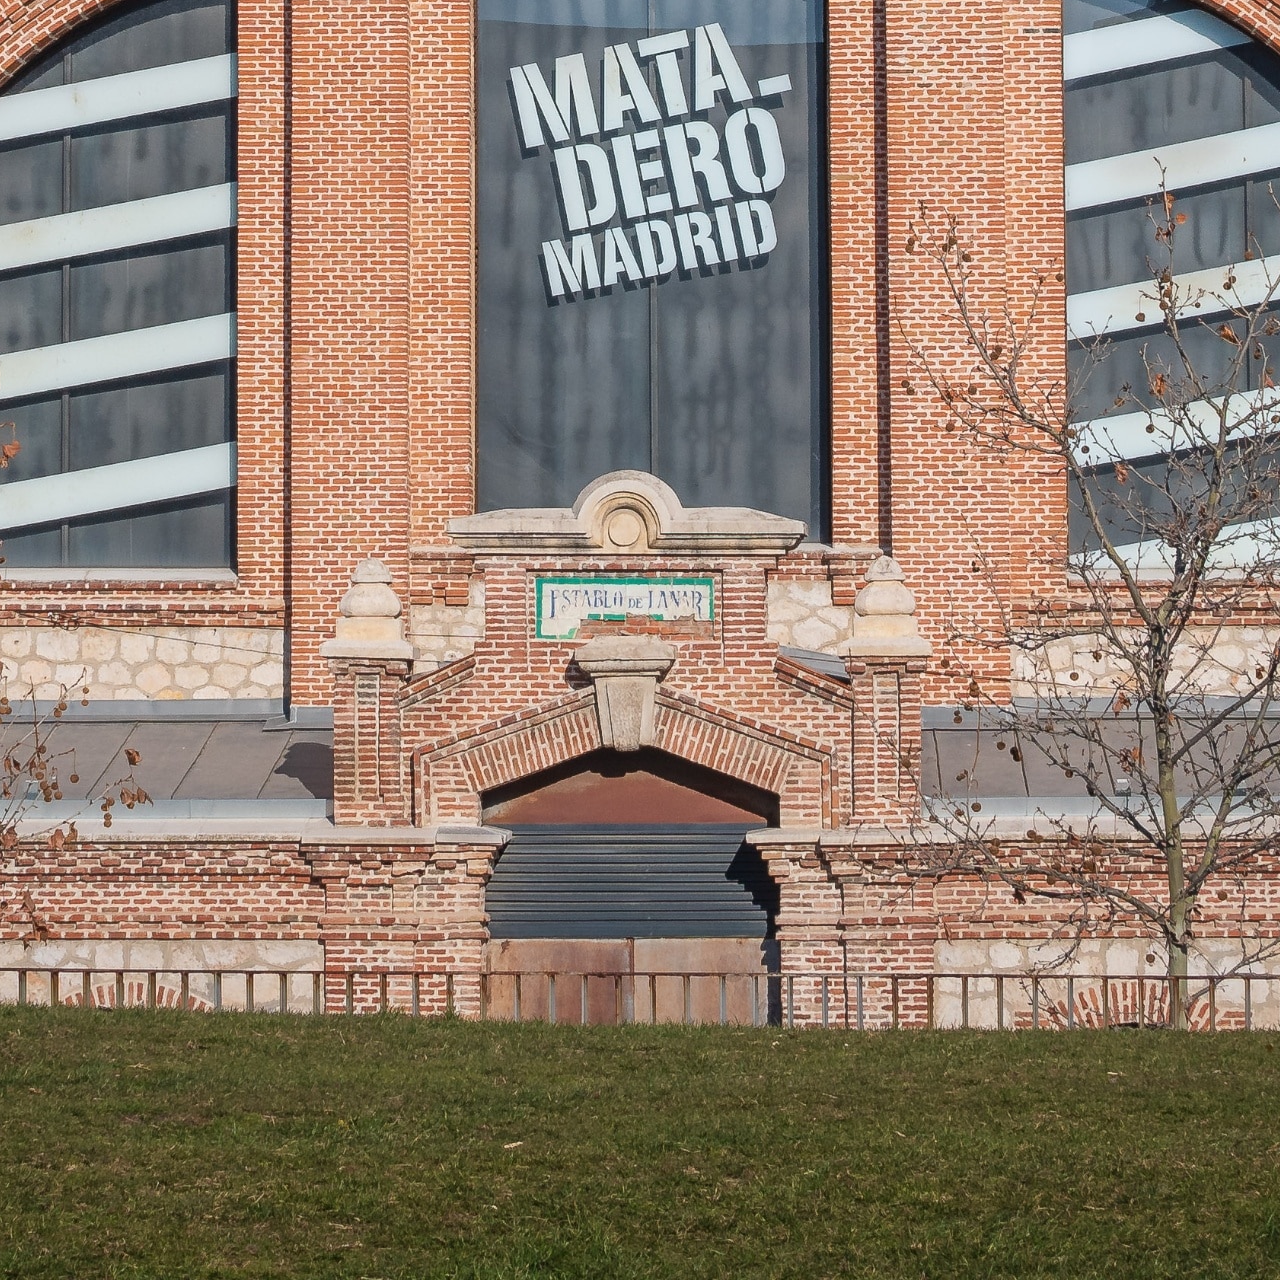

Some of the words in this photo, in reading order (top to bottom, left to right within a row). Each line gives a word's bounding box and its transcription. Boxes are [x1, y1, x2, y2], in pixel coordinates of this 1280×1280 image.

[553, 107, 786, 232] DERO
[541, 199, 778, 297] MADRID
[549, 589, 624, 619] ESTABLO
[628, 596, 643, 609] DE
